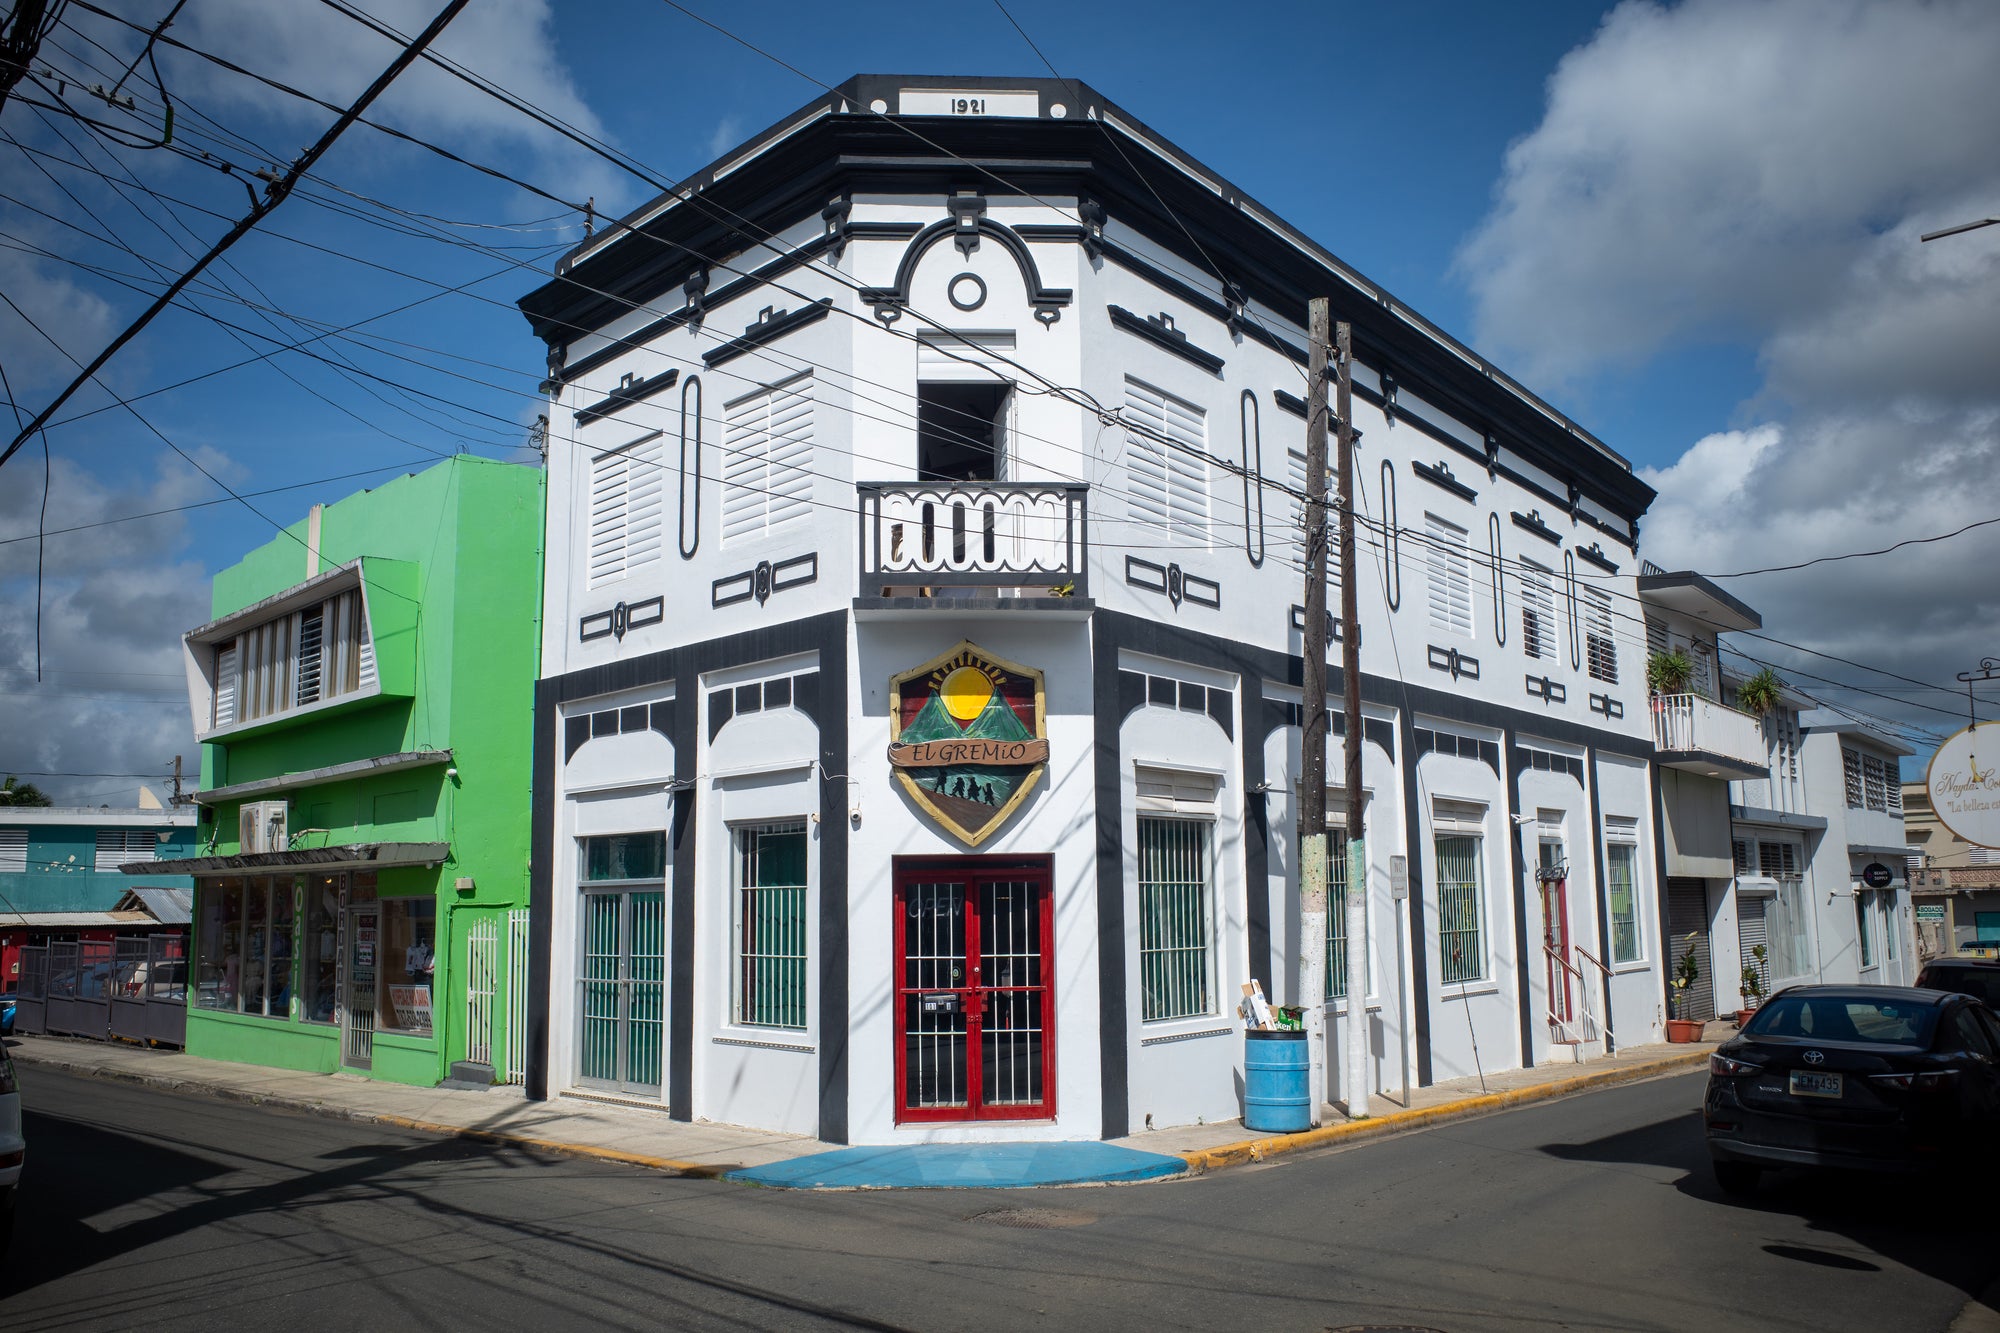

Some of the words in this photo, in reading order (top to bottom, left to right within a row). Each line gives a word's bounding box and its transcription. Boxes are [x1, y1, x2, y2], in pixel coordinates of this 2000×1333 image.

[951, 98, 985, 115] 1921
[912, 744, 936, 761] El
[908, 896, 964, 918] OPEN
[1820, 1078, 1839, 1090] 435
